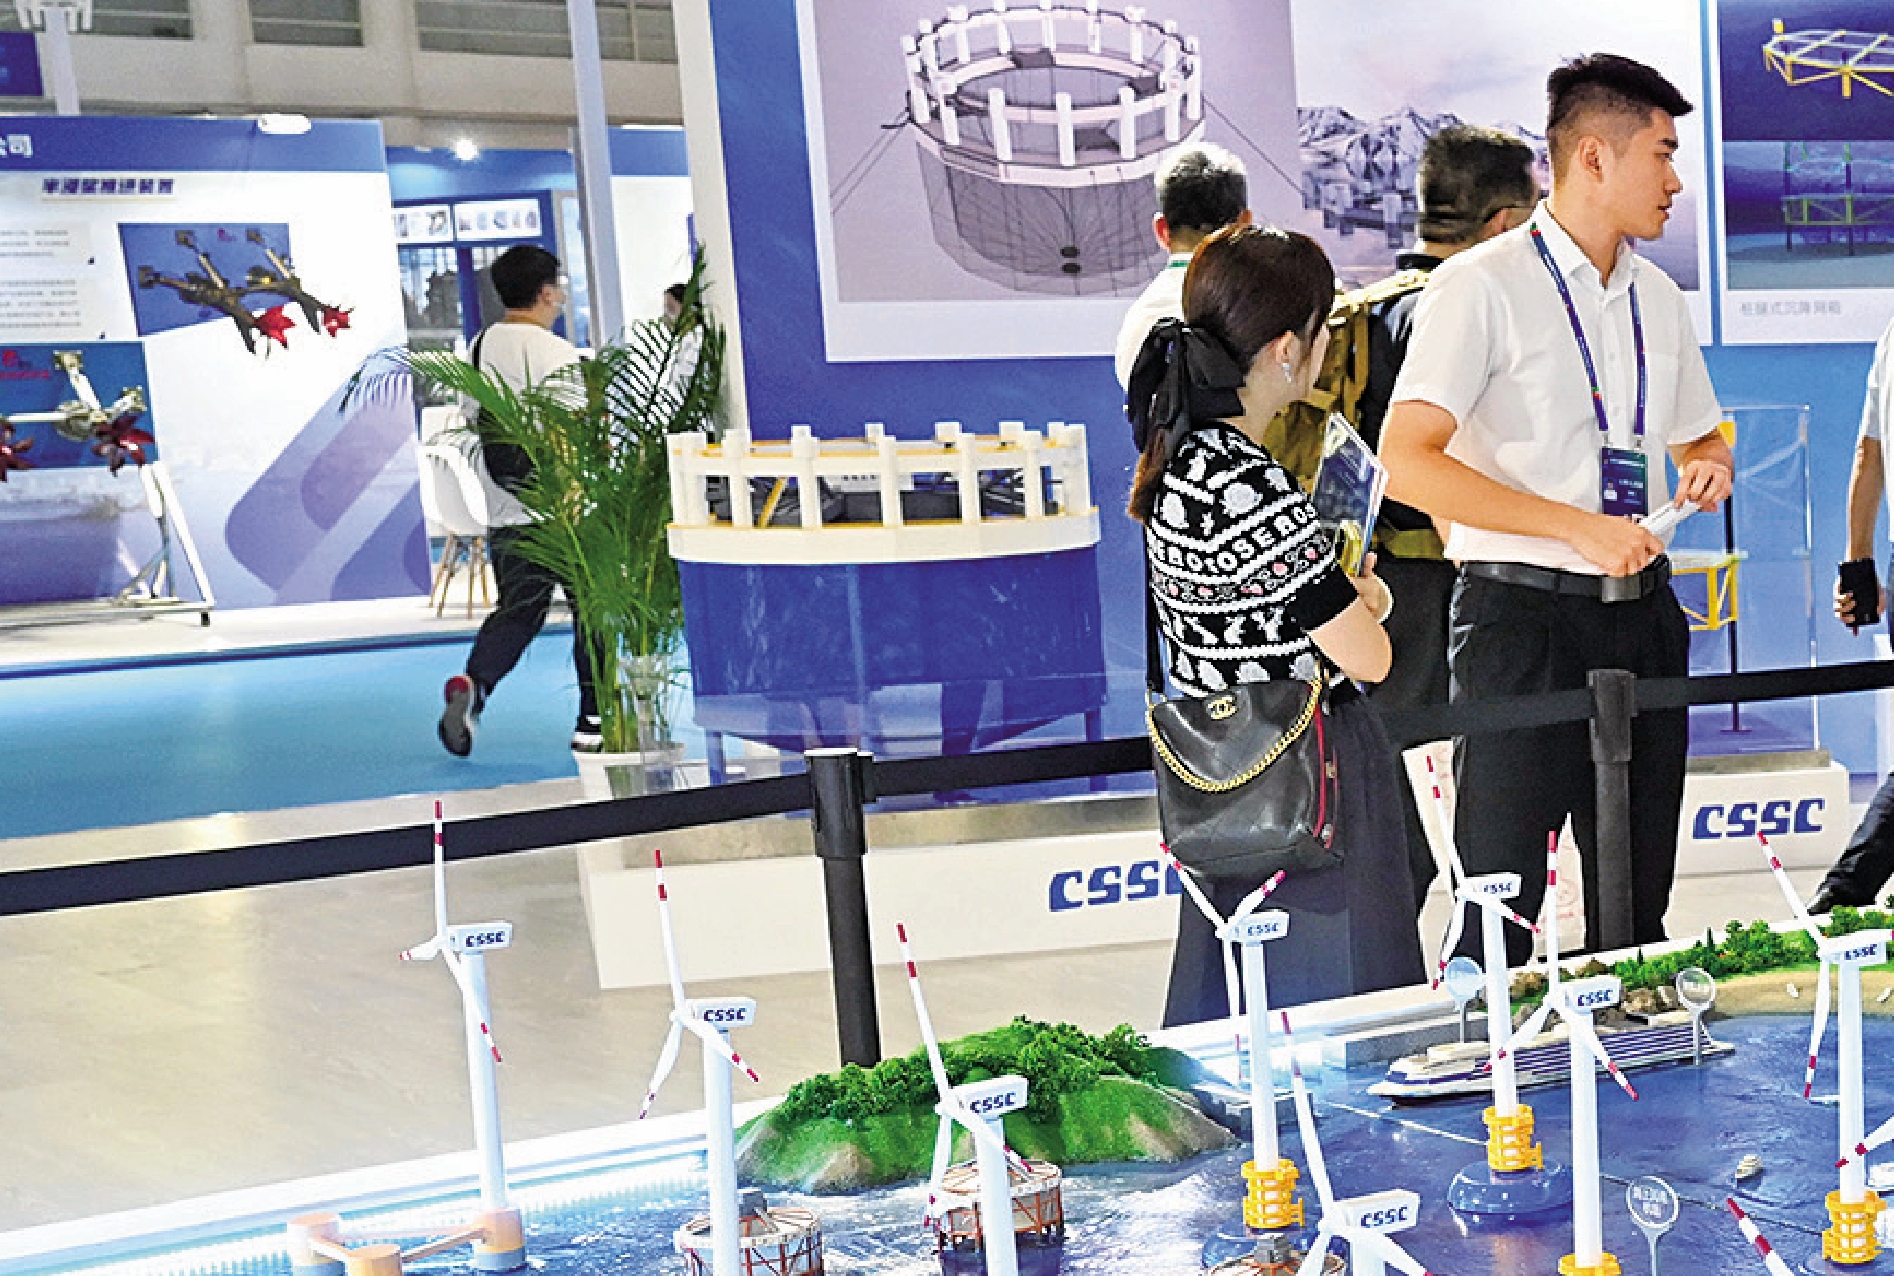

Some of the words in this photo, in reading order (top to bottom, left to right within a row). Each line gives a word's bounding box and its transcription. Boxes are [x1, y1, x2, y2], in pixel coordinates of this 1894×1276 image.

[1693, 797, 1825, 841] CSSC
[1248, 922, 1279, 936] CSSC
[466, 931, 505, 948] CSSC
[1844, 944, 1878, 961] CSSC
[1578, 989, 1614, 1007] CSSC
[703, 1007, 746, 1023] CSSC
[970, 1093, 1017, 1114] CSSC
[1361, 1206, 1409, 1229] CSSC
